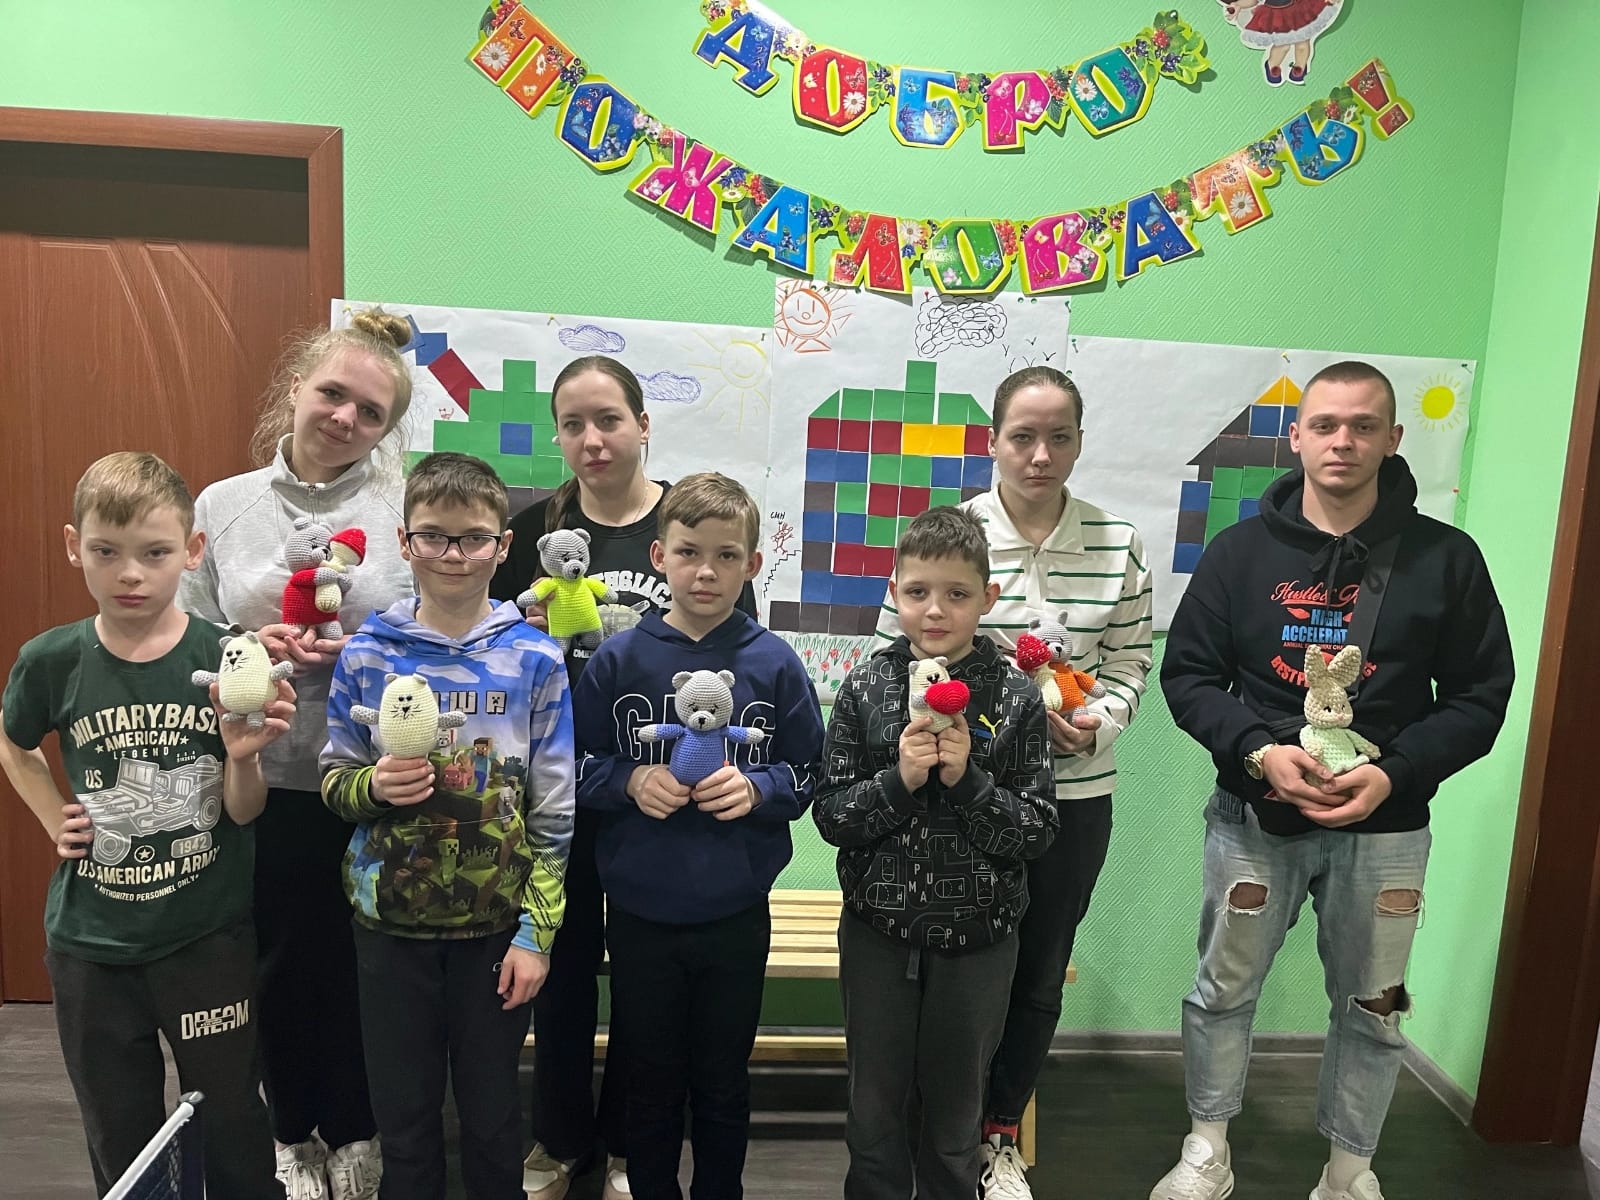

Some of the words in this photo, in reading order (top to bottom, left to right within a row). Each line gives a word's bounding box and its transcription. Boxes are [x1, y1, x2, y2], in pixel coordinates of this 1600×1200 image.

[695, 9, 1149, 149] ДОБРО
[1311, 608, 1343, 628] HIGH
[1282, 625, 1348, 644] ACCELERAT
[105, 730, 179, 752] AMERICAN
[179, 837, 208, 855] 1942
[97, 860, 176, 885] AMERICAN
[99, 886, 135, 902] AUTHORIZED
[136, 884, 177, 902] PERSONNEL
[181, 999, 249, 1040] DREAM
